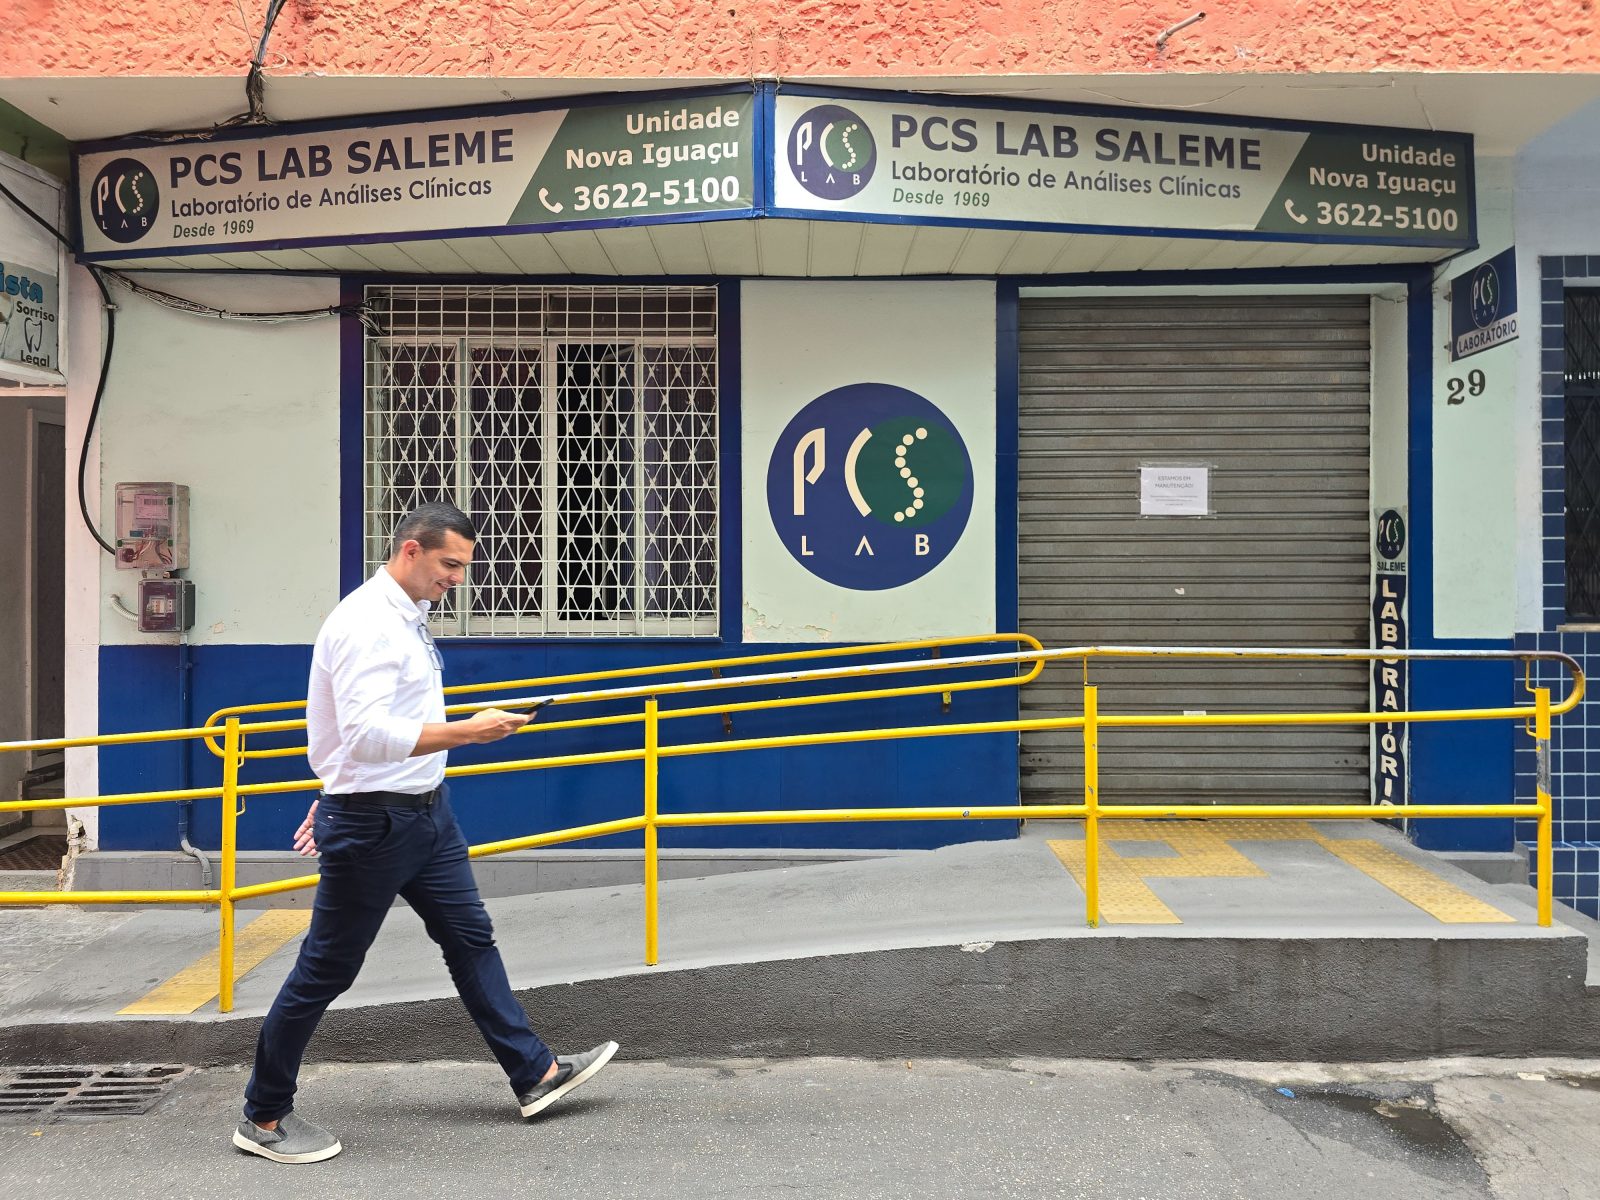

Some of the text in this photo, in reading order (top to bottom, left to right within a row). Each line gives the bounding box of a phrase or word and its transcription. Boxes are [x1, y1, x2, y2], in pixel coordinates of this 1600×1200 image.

[626, 106, 740, 135] Unidade
[170, 129, 514, 188] PCS LAB SALEME
[566, 140, 739, 170] Nova Iguaçu
[796, 121, 858, 170] PCS
[891, 114, 1261, 171] PCS LAB SALEME
[1361, 143, 1456, 168] Unidade
[97, 171, 144, 215] PCS
[573, 175, 740, 211] 3622-5100
[892, 160, 1241, 199] Laboratório de Análises Clínicas
[1309, 166, 1457, 198] Nova Iguaçu
[171, 177, 492, 217] Laboratório de Análises Clínicas
[893, 188, 990, 208] Desde 1969
[173, 219, 254, 239] Desde 1969
[1316, 202, 1458, 232] 3622-5100
[16, 301, 55, 322] Sorriso
[1458, 319, 1517, 353] LABORATÓRIO
[20, 350, 50, 367] Legal
[1446, 369, 1486, 405] 29
[793, 427, 928, 522] PCS
[1378, 518, 1399, 543] PCS
[1377, 561, 1406, 572] SALEME
